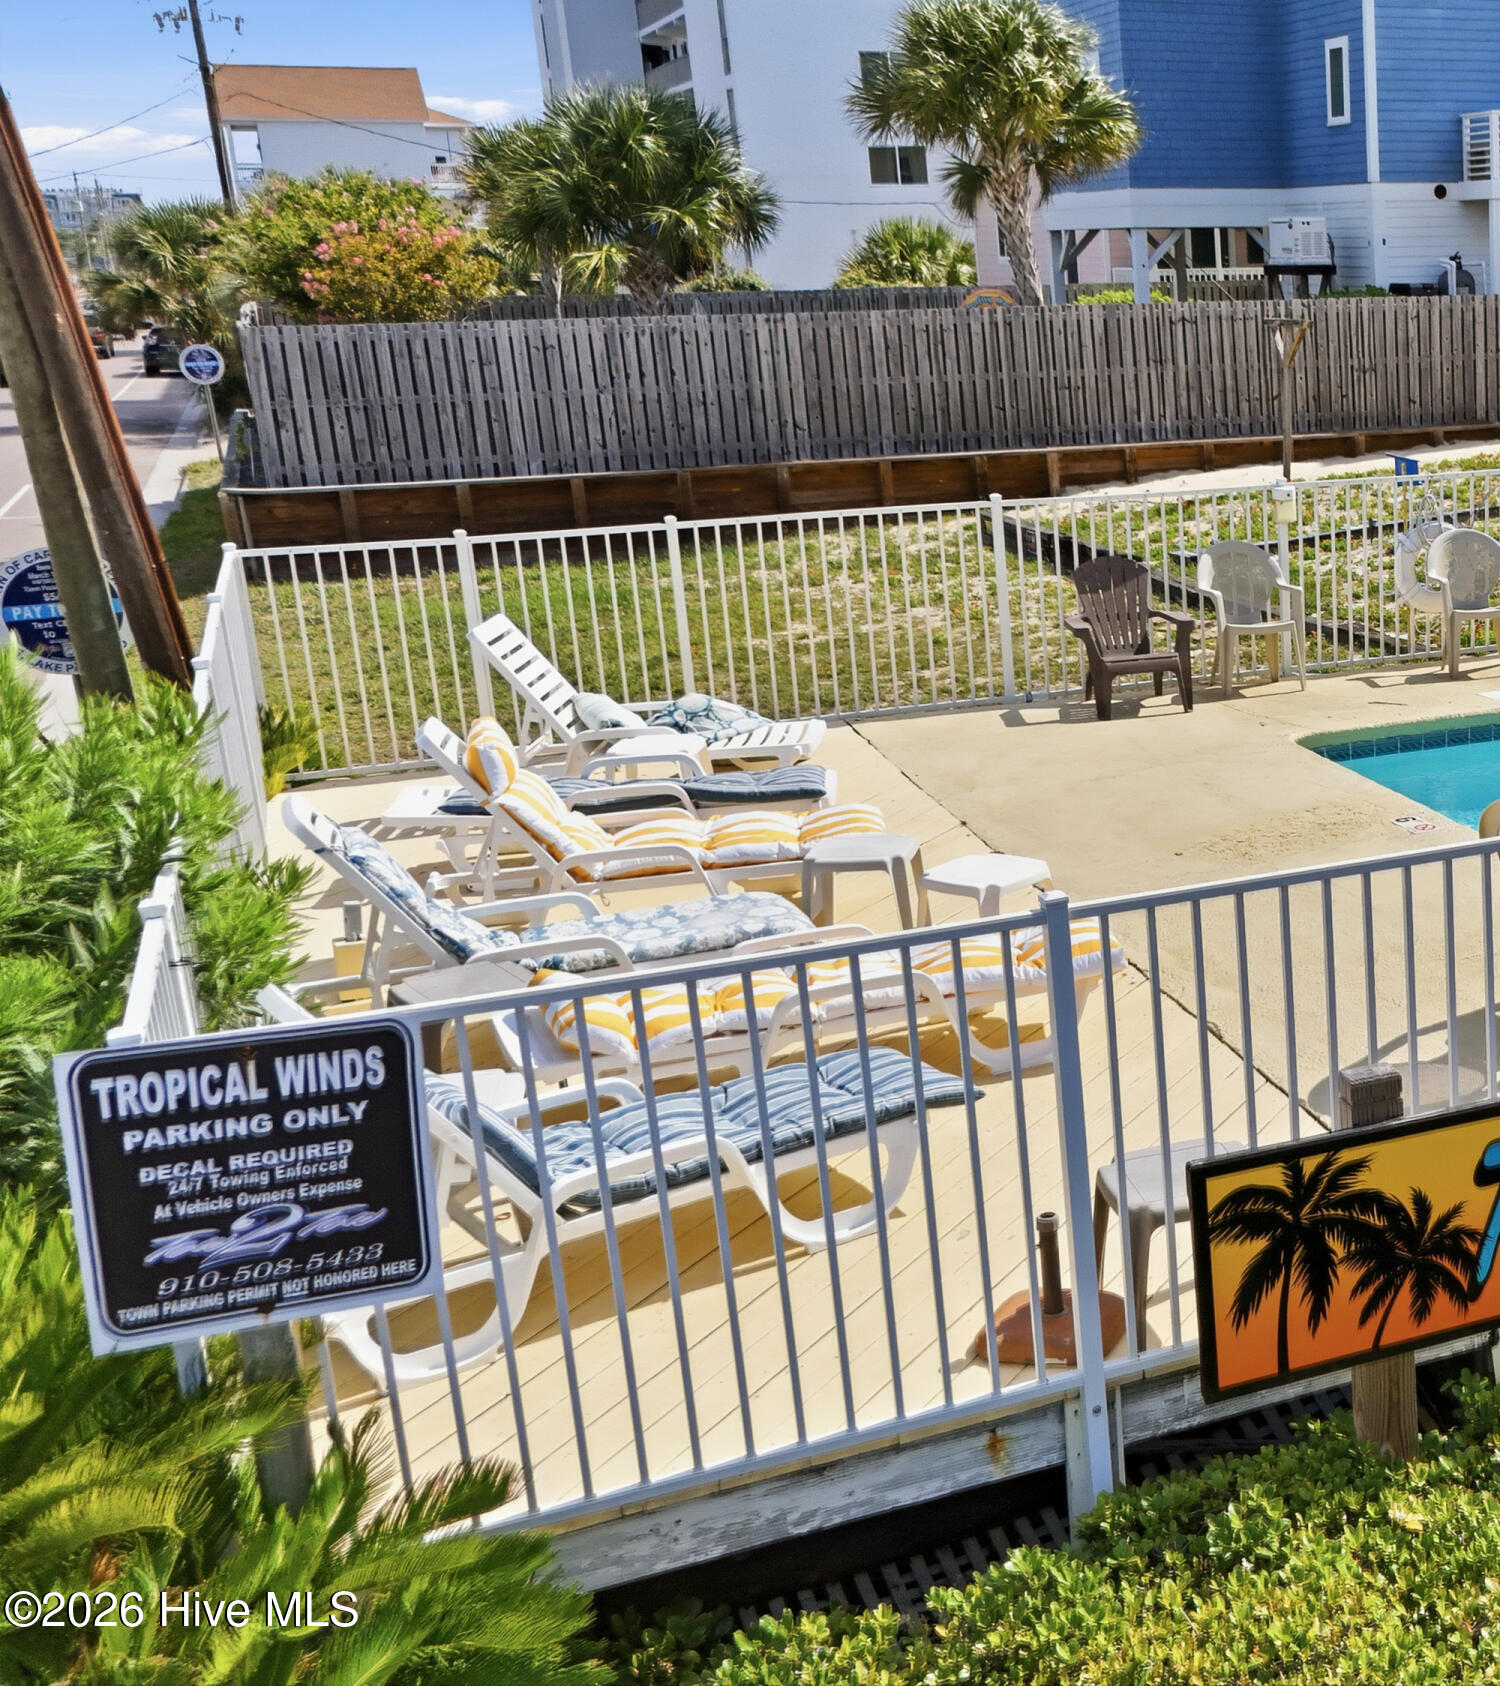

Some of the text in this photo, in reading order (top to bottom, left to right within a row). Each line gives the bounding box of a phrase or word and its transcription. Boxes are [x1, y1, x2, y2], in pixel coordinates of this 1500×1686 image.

[5, 560, 21, 575] OF
[12, 605, 41, 621] PAY
[90, 1045, 386, 1122] TROPICAL WINDS
[123, 1100, 369, 1153] PARKING ONLY
[139, 1139, 354, 1186] DECAL REQUIRED
[168, 1156, 348, 1197] 24/7 Towing Enforced
[154, 1175, 364, 1223] At Vehicle Owners Expense
[117, 1258, 417, 1323] TOWN PARKING PERMIT NOT HONORED HERE
[157, 1242, 385, 1298] 910-508-5433
